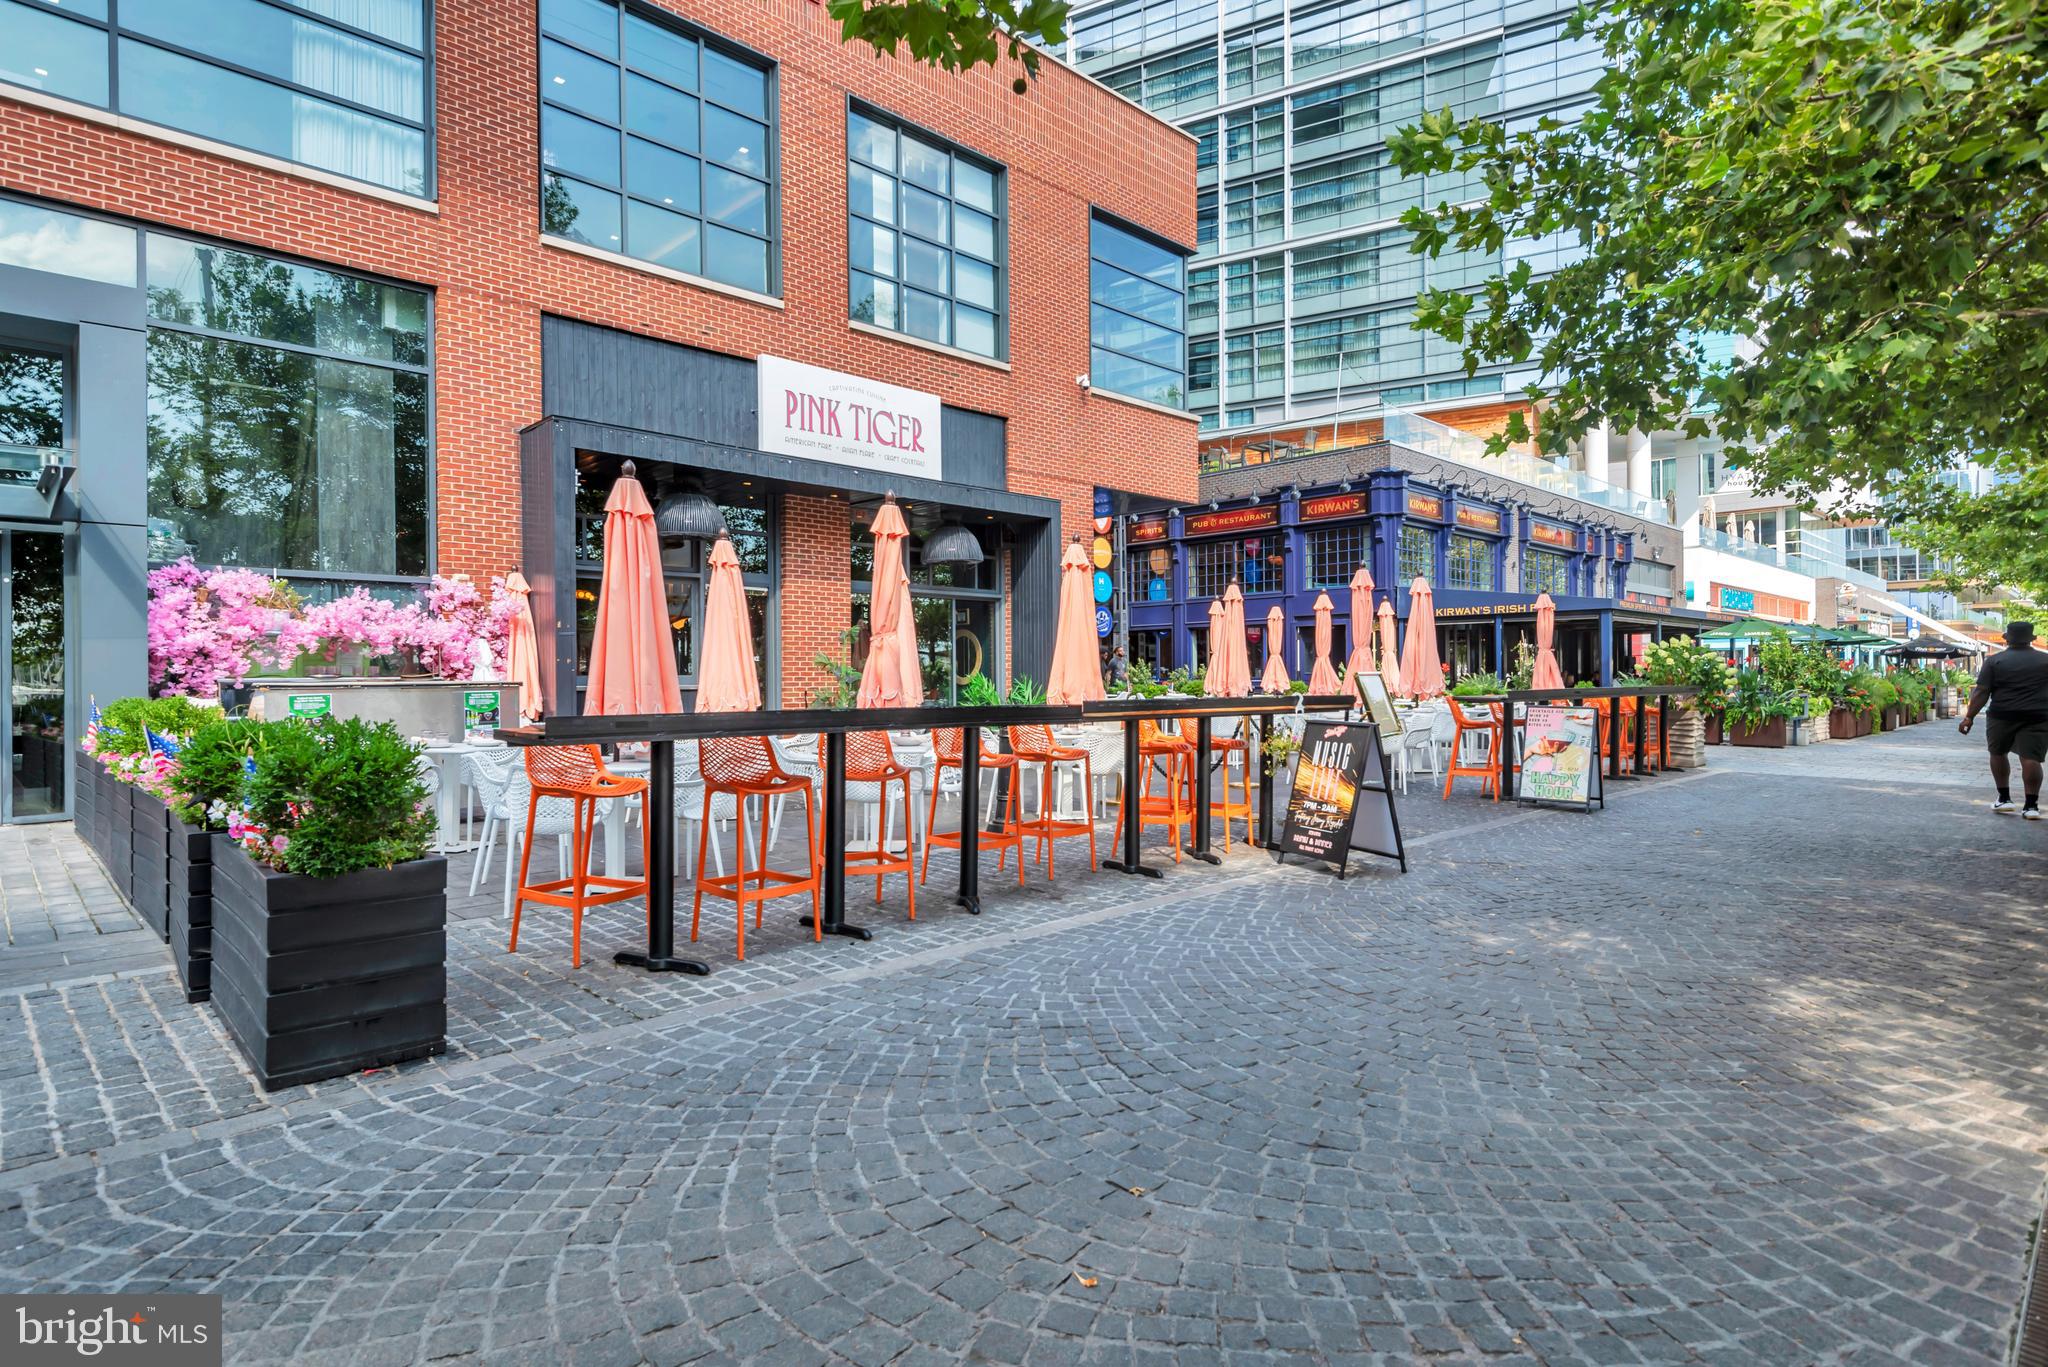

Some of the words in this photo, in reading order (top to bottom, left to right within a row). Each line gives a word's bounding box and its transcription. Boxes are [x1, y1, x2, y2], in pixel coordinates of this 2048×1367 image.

[785, 389, 843, 438] PINK
[848, 402, 925, 454] TIGER
[1306, 498, 1360, 515] KIRWAN'S
[1409, 499, 1437, 514] KIRWAN'S
[1192, 519, 1210, 529] PUB
[1218, 511, 1273, 525] RESTAURANT
[1135, 526, 1163, 537] SPIRITS
[1435, 606, 1491, 617] KIRWAN'S
[1494, 604, 1527, 614] IRISH
[1312, 740, 1353, 770] MUSIC
[1308, 767, 1343, 801] LIVE
[1530, 771, 1581, 787] HAPPY
[1534, 785, 1574, 799] HOUR
[1303, 800, 1318, 811] 7PM
[1321, 803, 1338, 813] 2AM
